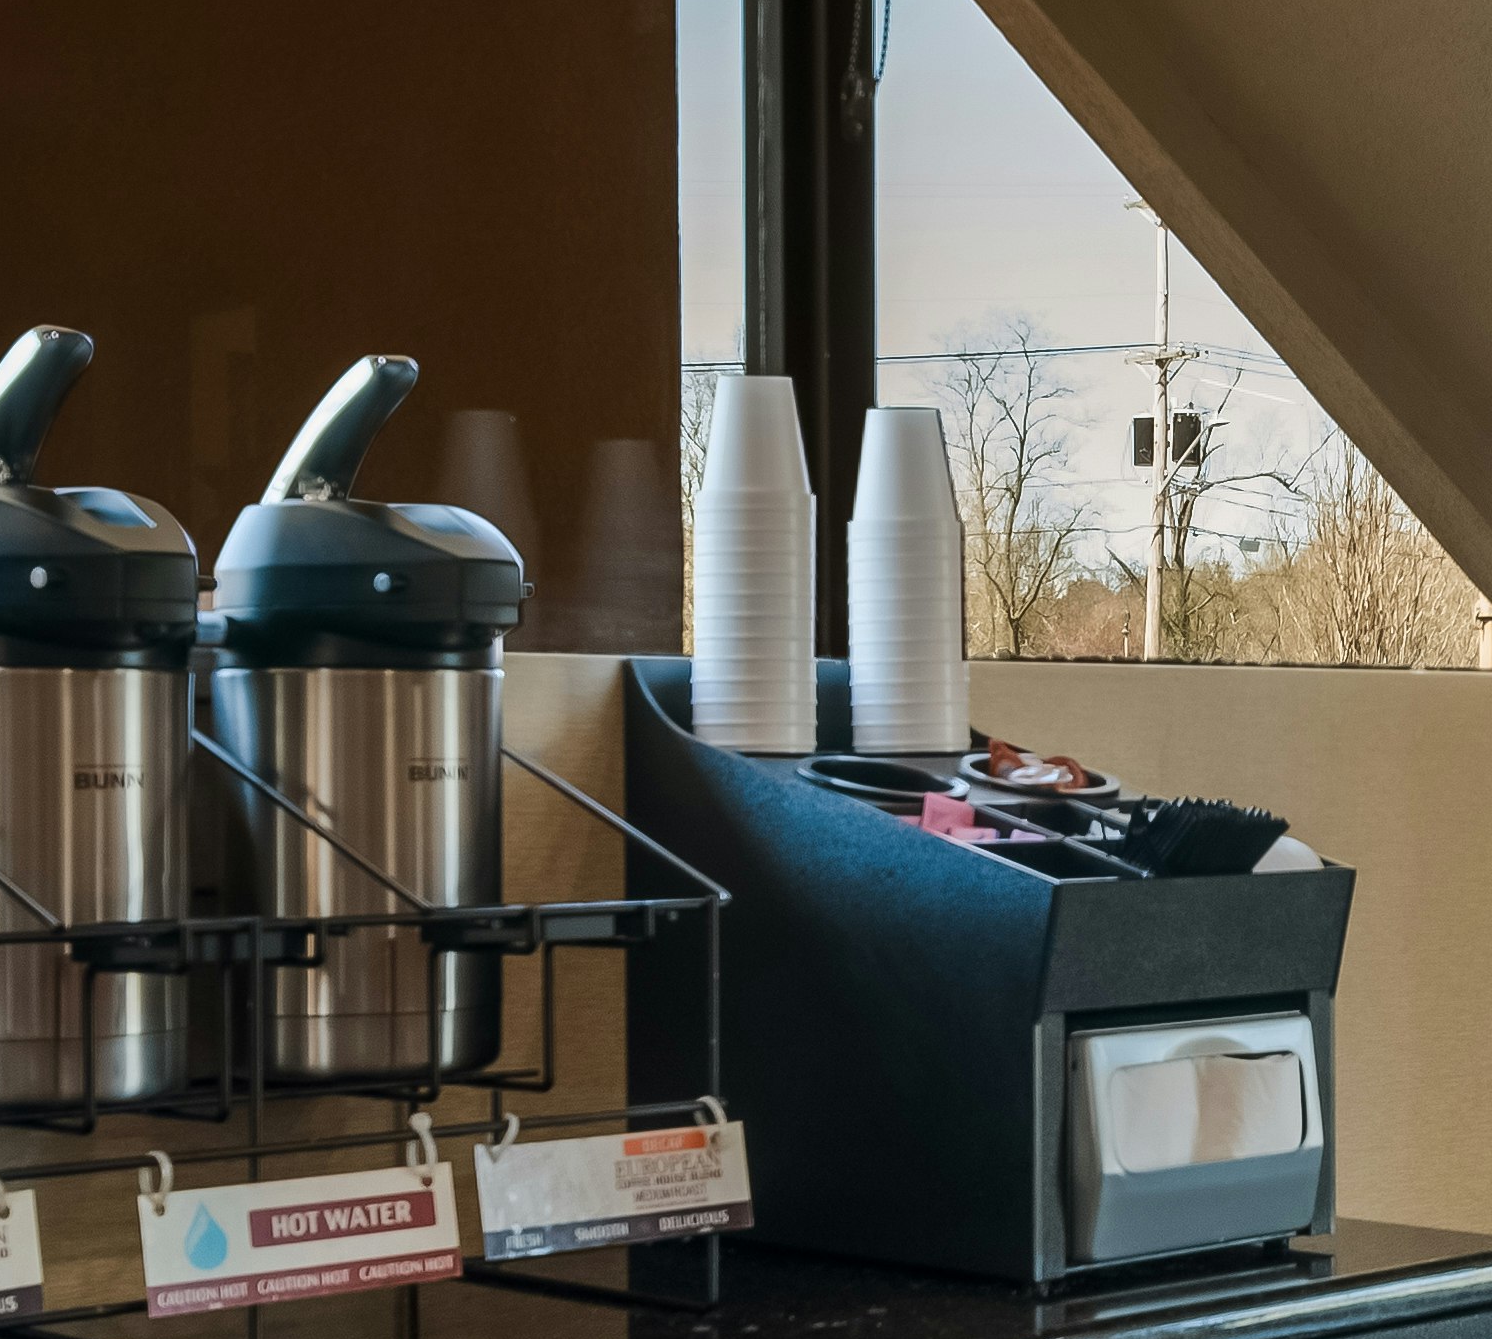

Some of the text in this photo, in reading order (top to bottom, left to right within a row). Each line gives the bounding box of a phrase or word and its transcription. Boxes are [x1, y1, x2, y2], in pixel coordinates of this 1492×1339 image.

[74, 772, 145, 791] BUNN
[271, 1199, 414, 1239] HOT WATER
[158, 1255, 455, 1308] CAUTION HOT CAUTION HOT CAUTION HOT
